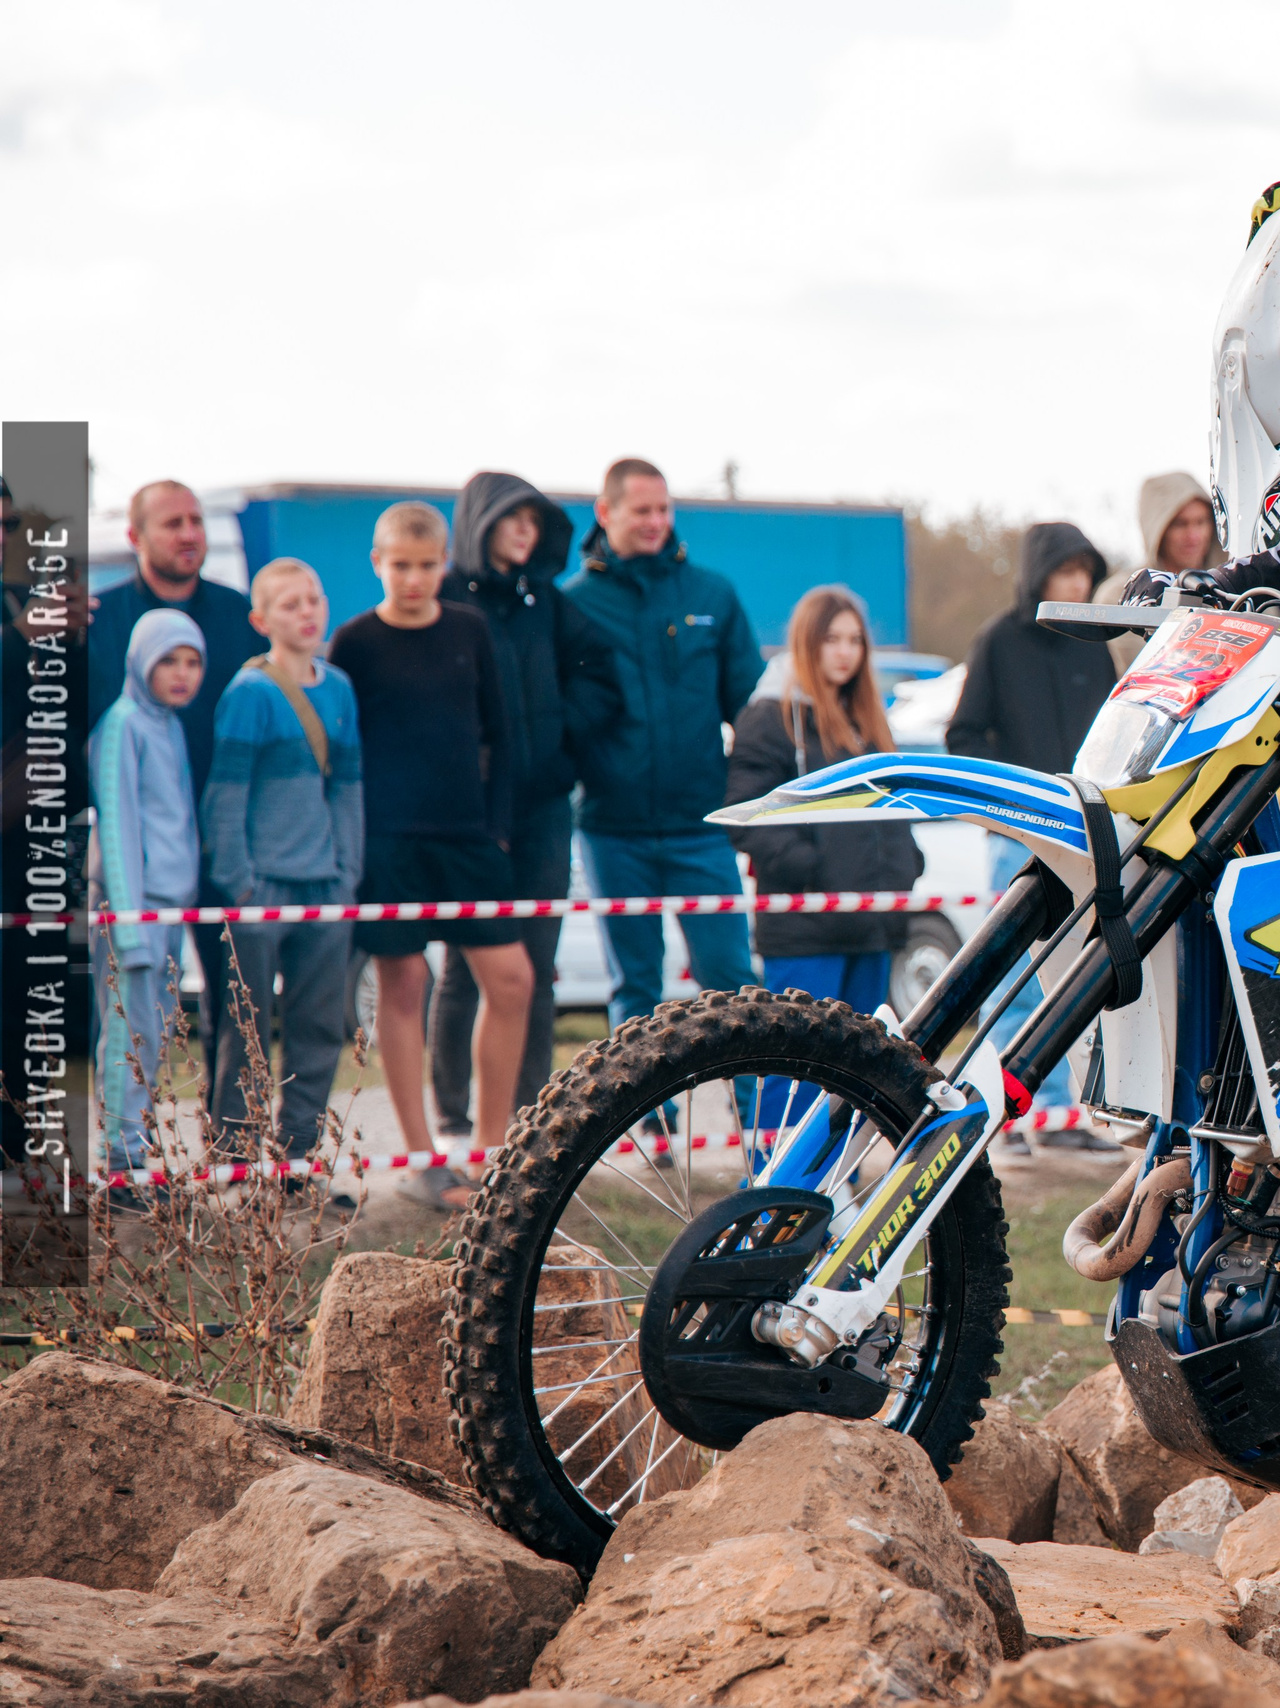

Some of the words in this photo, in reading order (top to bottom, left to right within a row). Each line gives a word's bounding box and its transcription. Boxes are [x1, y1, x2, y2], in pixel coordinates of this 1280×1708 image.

[1055, 606, 1090, 618] КВАДРО
[1094, 609, 1107, 619] 93
[1196, 629, 1257, 648] BSE
[856, 1194, 916, 1272] THOR
[914, 1132, 962, 1200] 300
